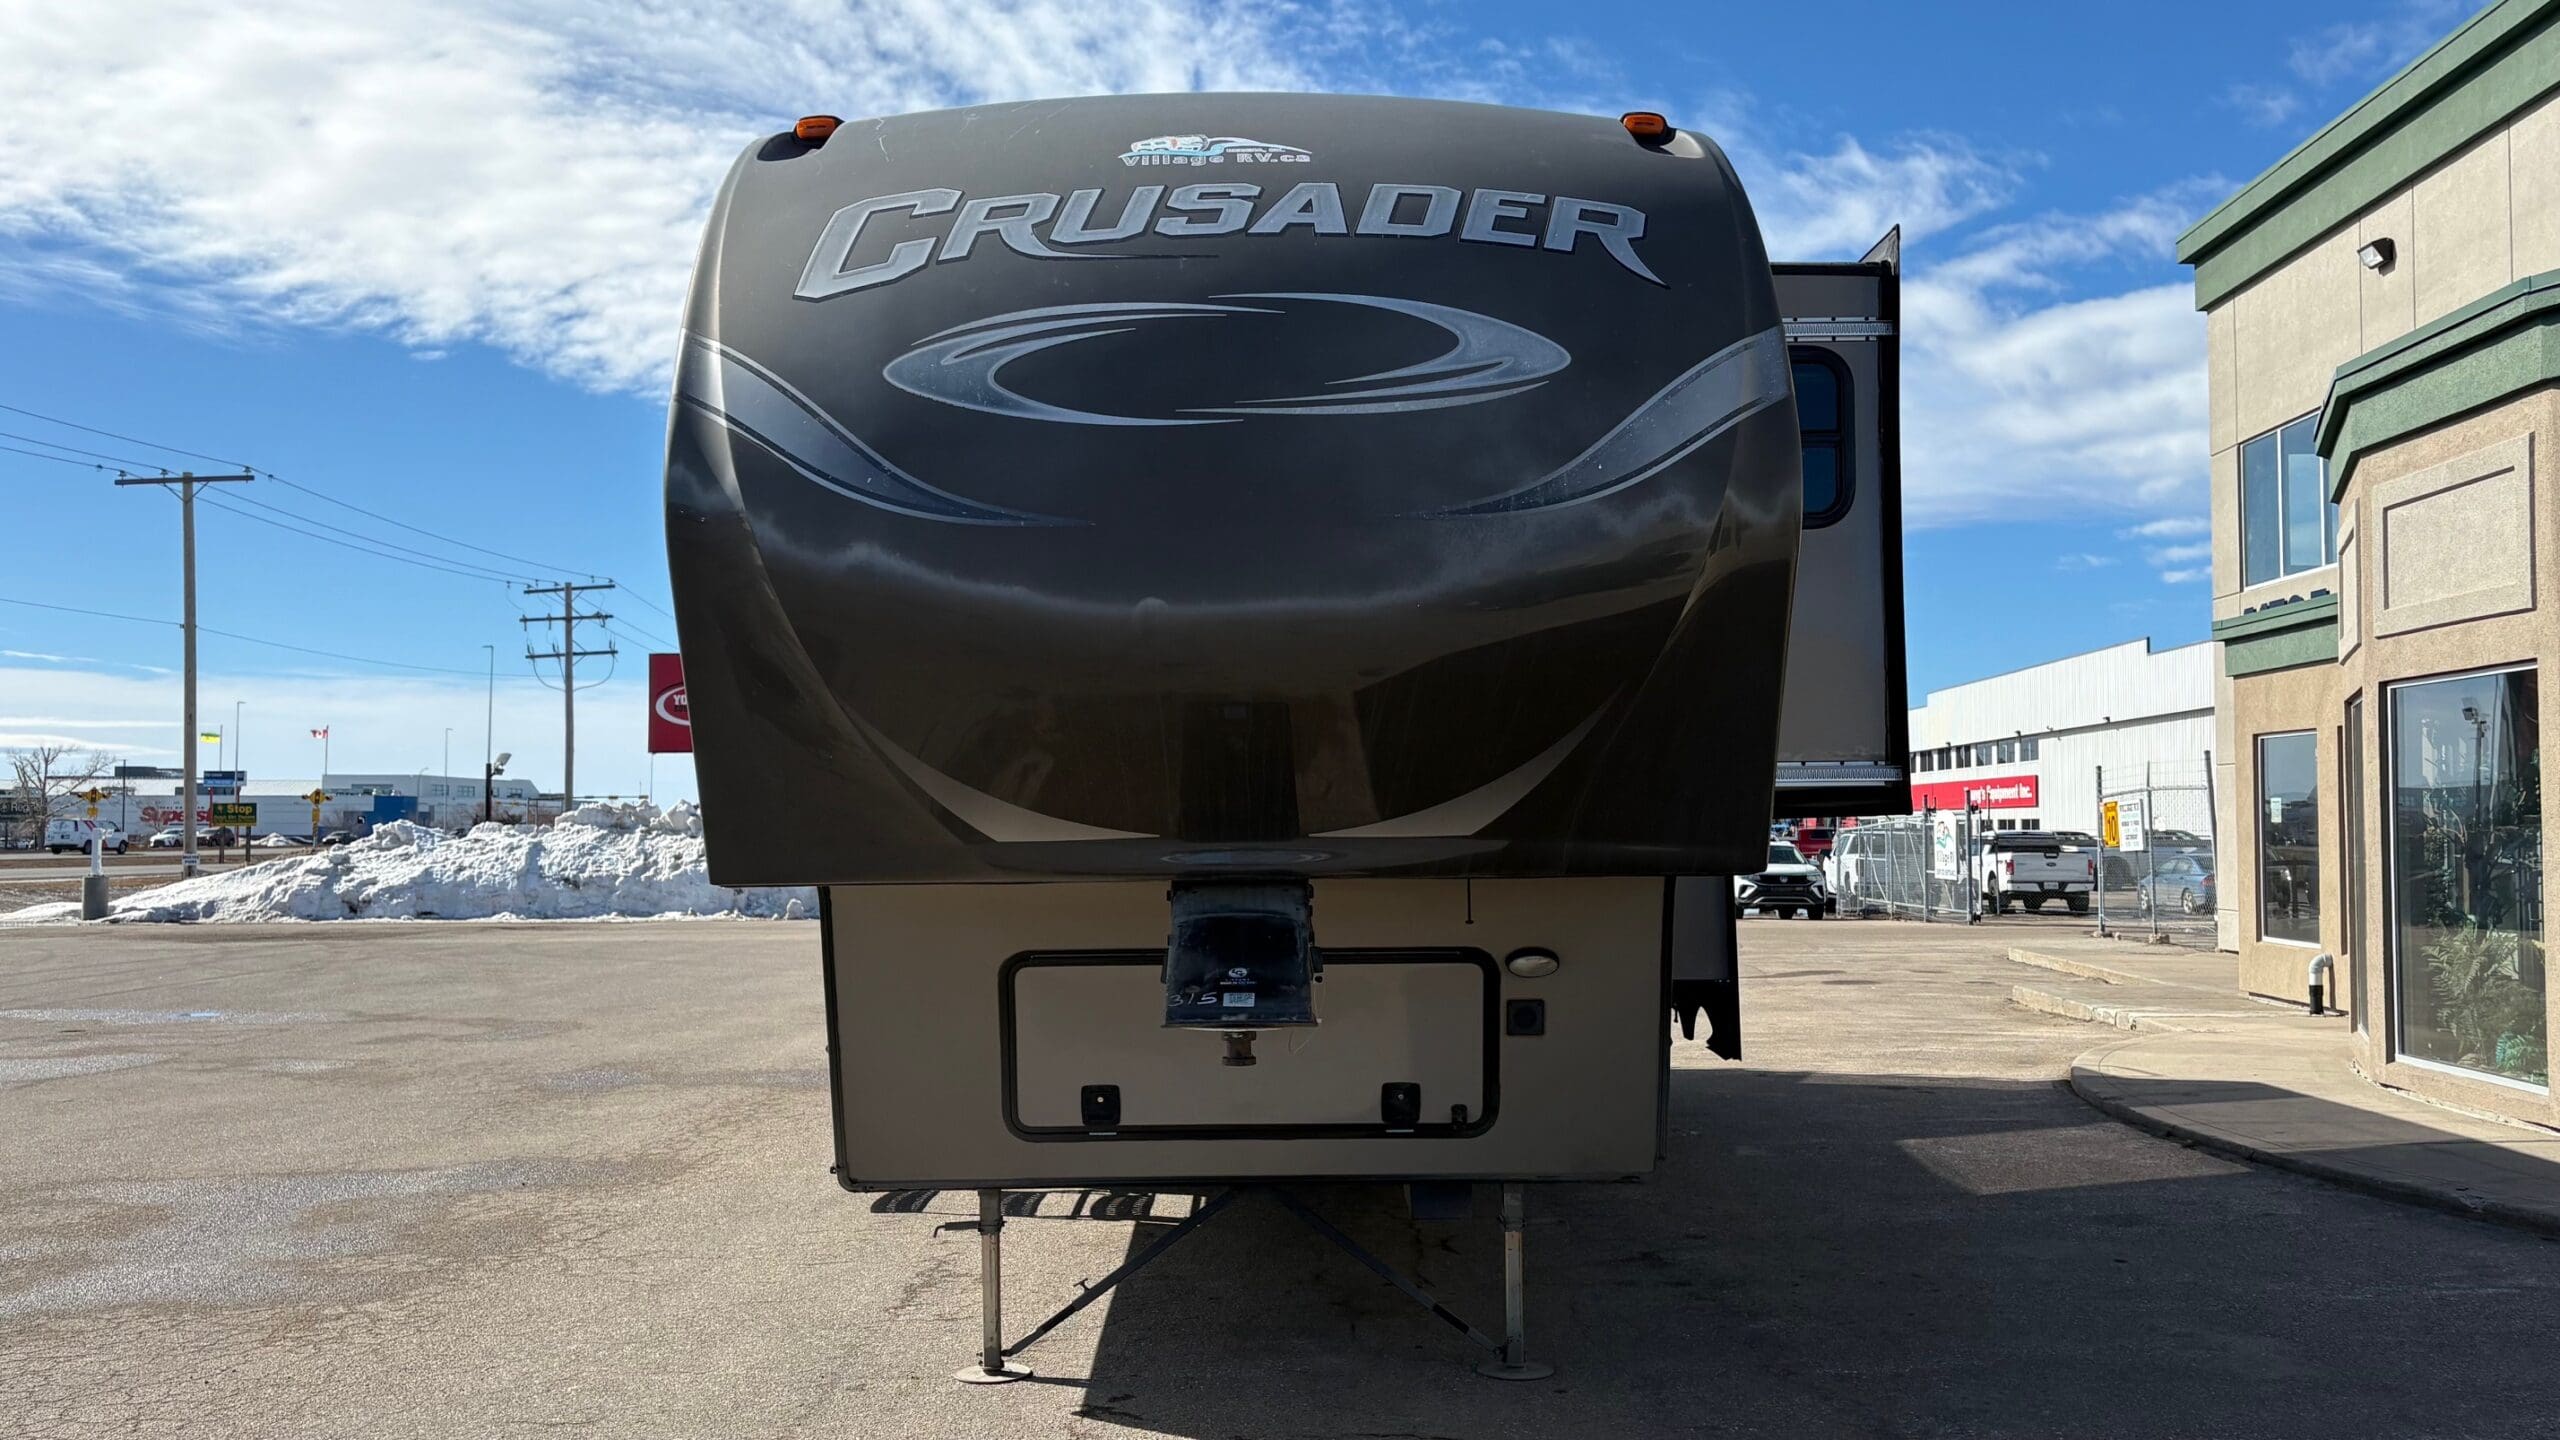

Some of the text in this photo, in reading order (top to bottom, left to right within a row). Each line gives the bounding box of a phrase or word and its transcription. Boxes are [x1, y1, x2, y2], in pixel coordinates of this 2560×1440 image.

[1121, 153, 1311, 167] Village RV.ca
[793, 182, 1671, 302] CRUSADER
[1986, 784, 2019, 803] Equipment
[226, 804, 253, 815] Stop
